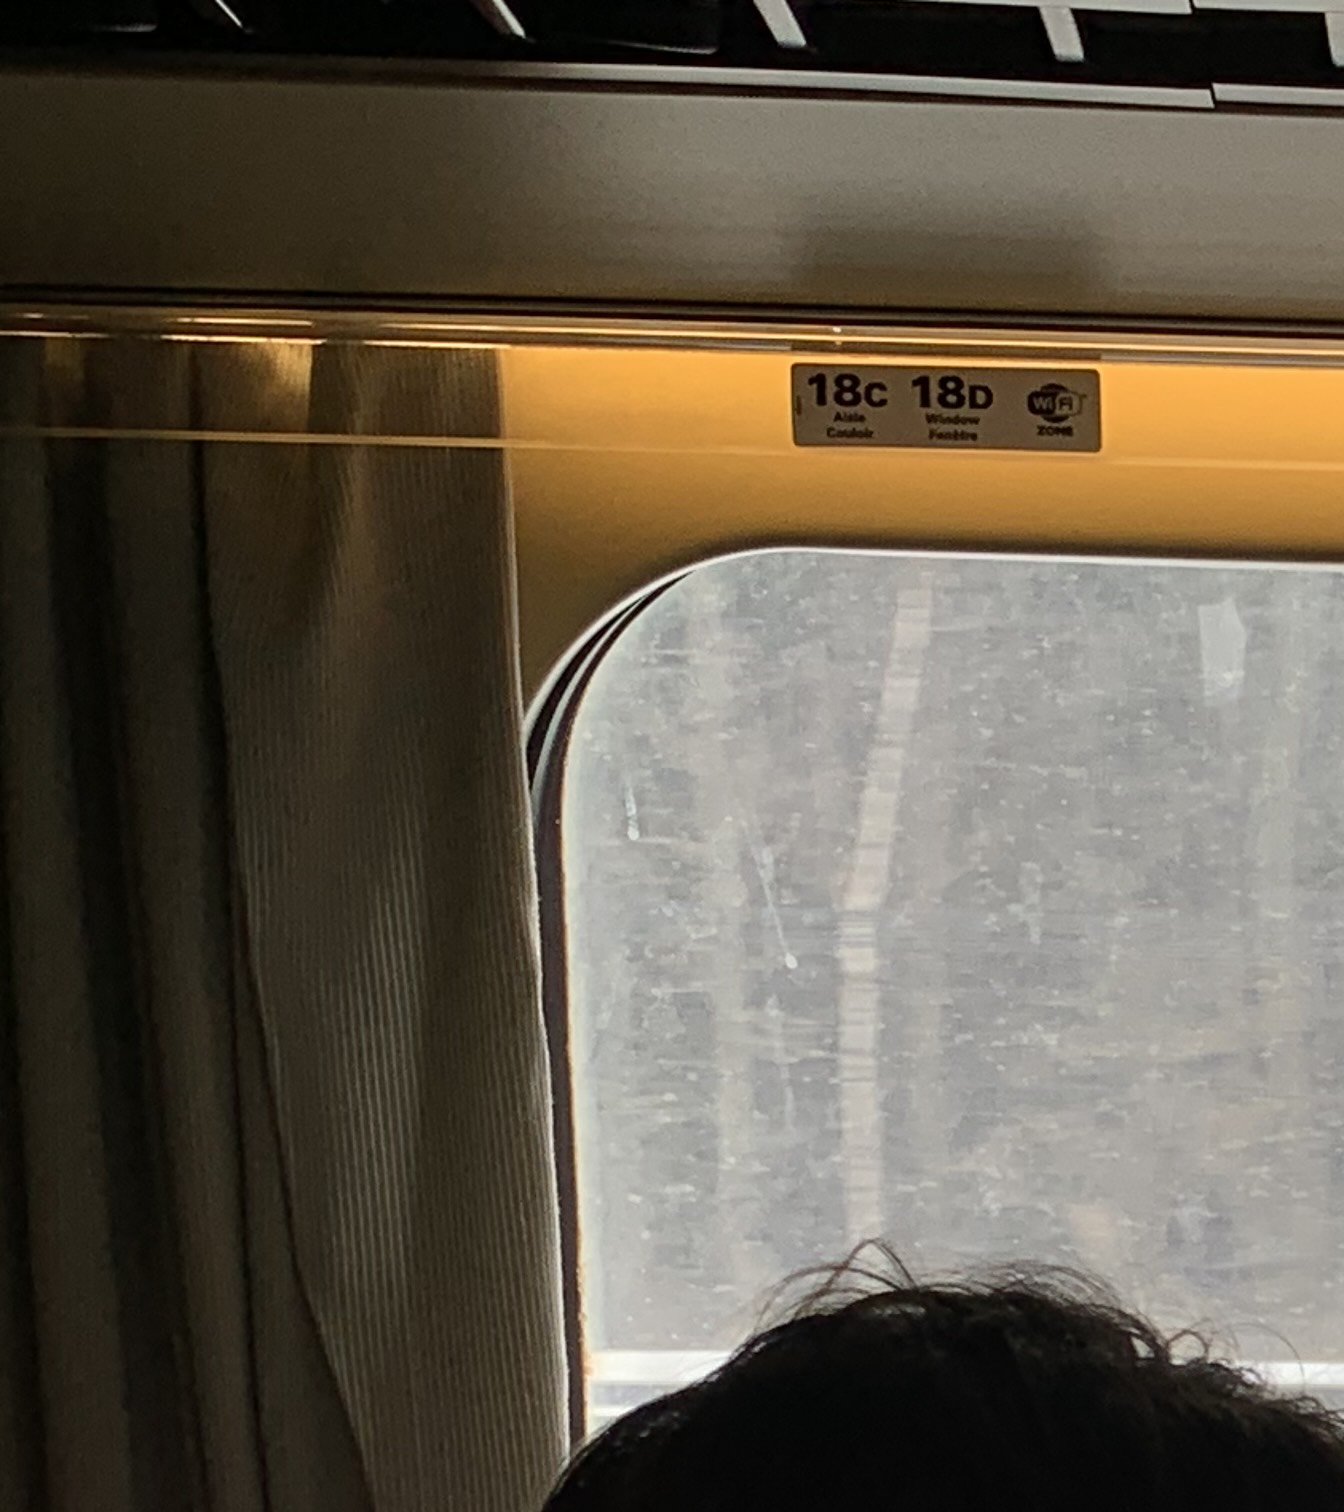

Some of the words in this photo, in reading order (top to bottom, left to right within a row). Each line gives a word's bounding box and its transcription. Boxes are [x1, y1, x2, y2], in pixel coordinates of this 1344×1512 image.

[807, 373, 888, 408] 18C
[911, 375, 994, 410] 18D
[832, 411, 867, 423] Aisle
[925, 412, 981, 425] Window
[826, 427, 875, 440] Couloir
[928, 427, 979, 443] Fenêtre
[1036, 424, 1074, 437] ZONE
